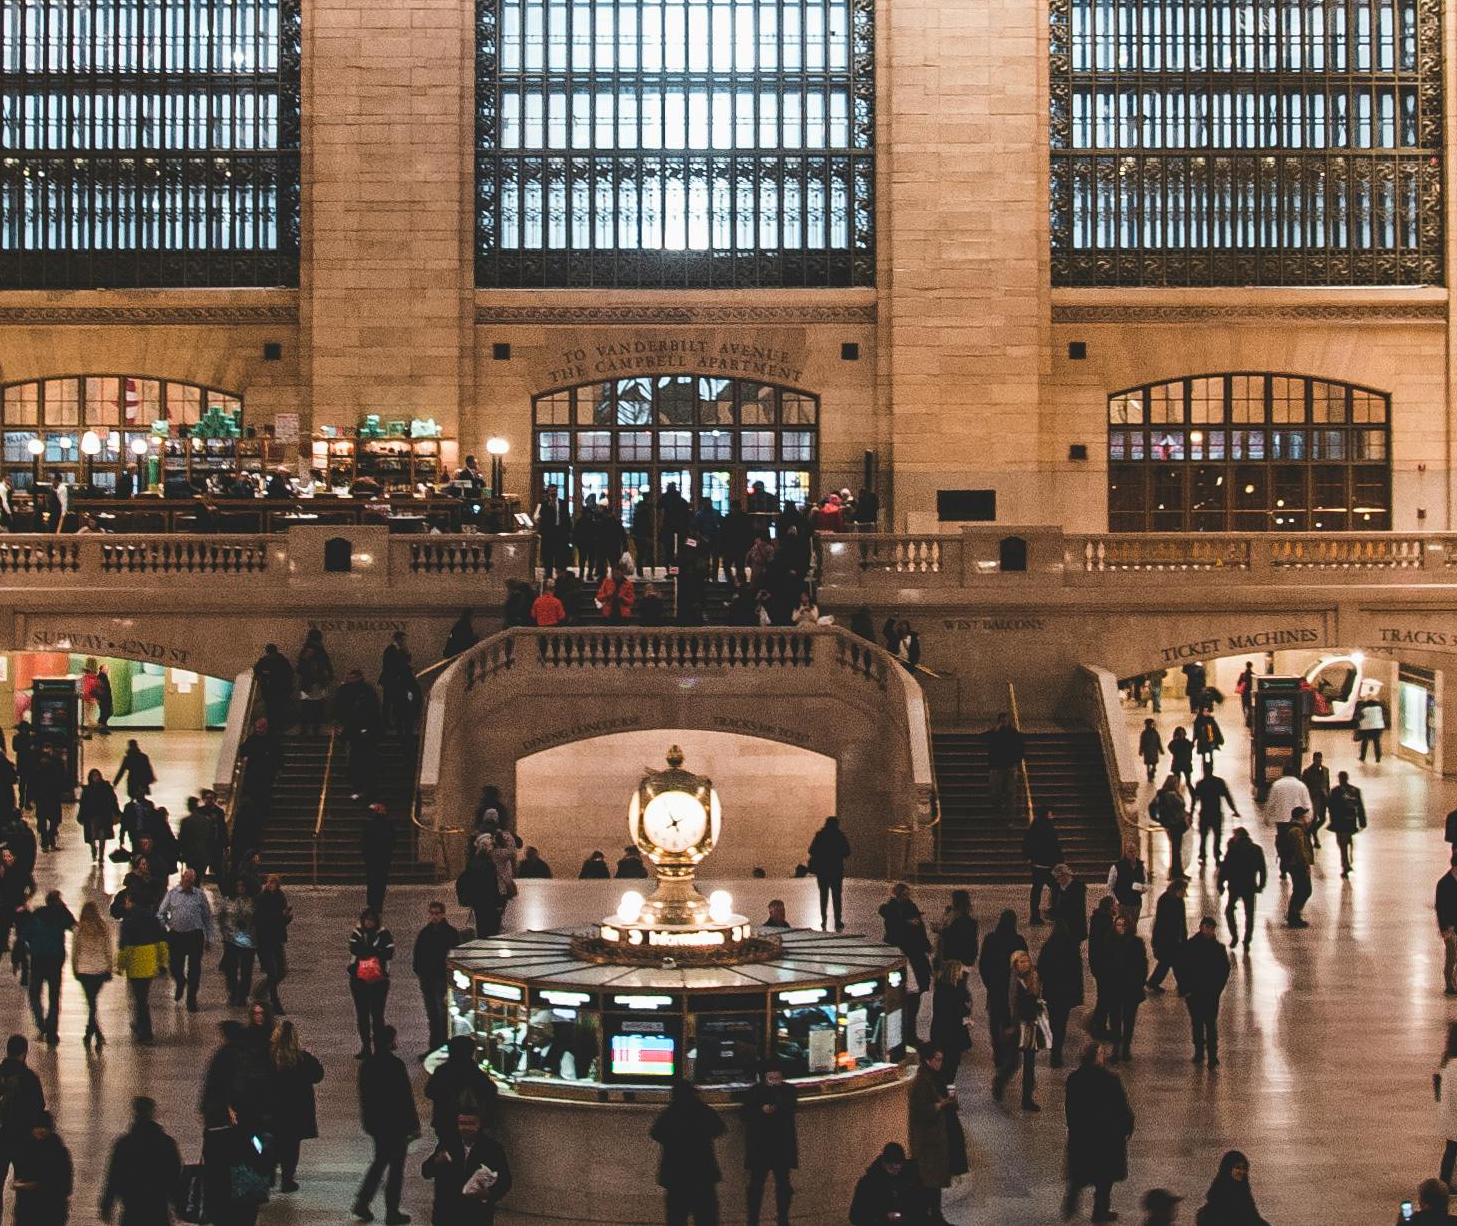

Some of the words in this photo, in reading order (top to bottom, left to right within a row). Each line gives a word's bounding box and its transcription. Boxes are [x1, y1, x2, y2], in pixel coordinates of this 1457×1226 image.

[562, 349, 587, 364] TO
[596, 340, 709, 358] VANDERBILT
[720, 342, 792, 363] AVENUE
[549, 366, 585, 383] THE
[595, 355, 687, 373] CAMPBELL
[698, 357, 802, 383] APARTMENT
[1160, 638, 1221, 662] TICKET
[1228, 628, 1318, 650] MACHINES
[1379, 627, 1447, 646] TRACKS
